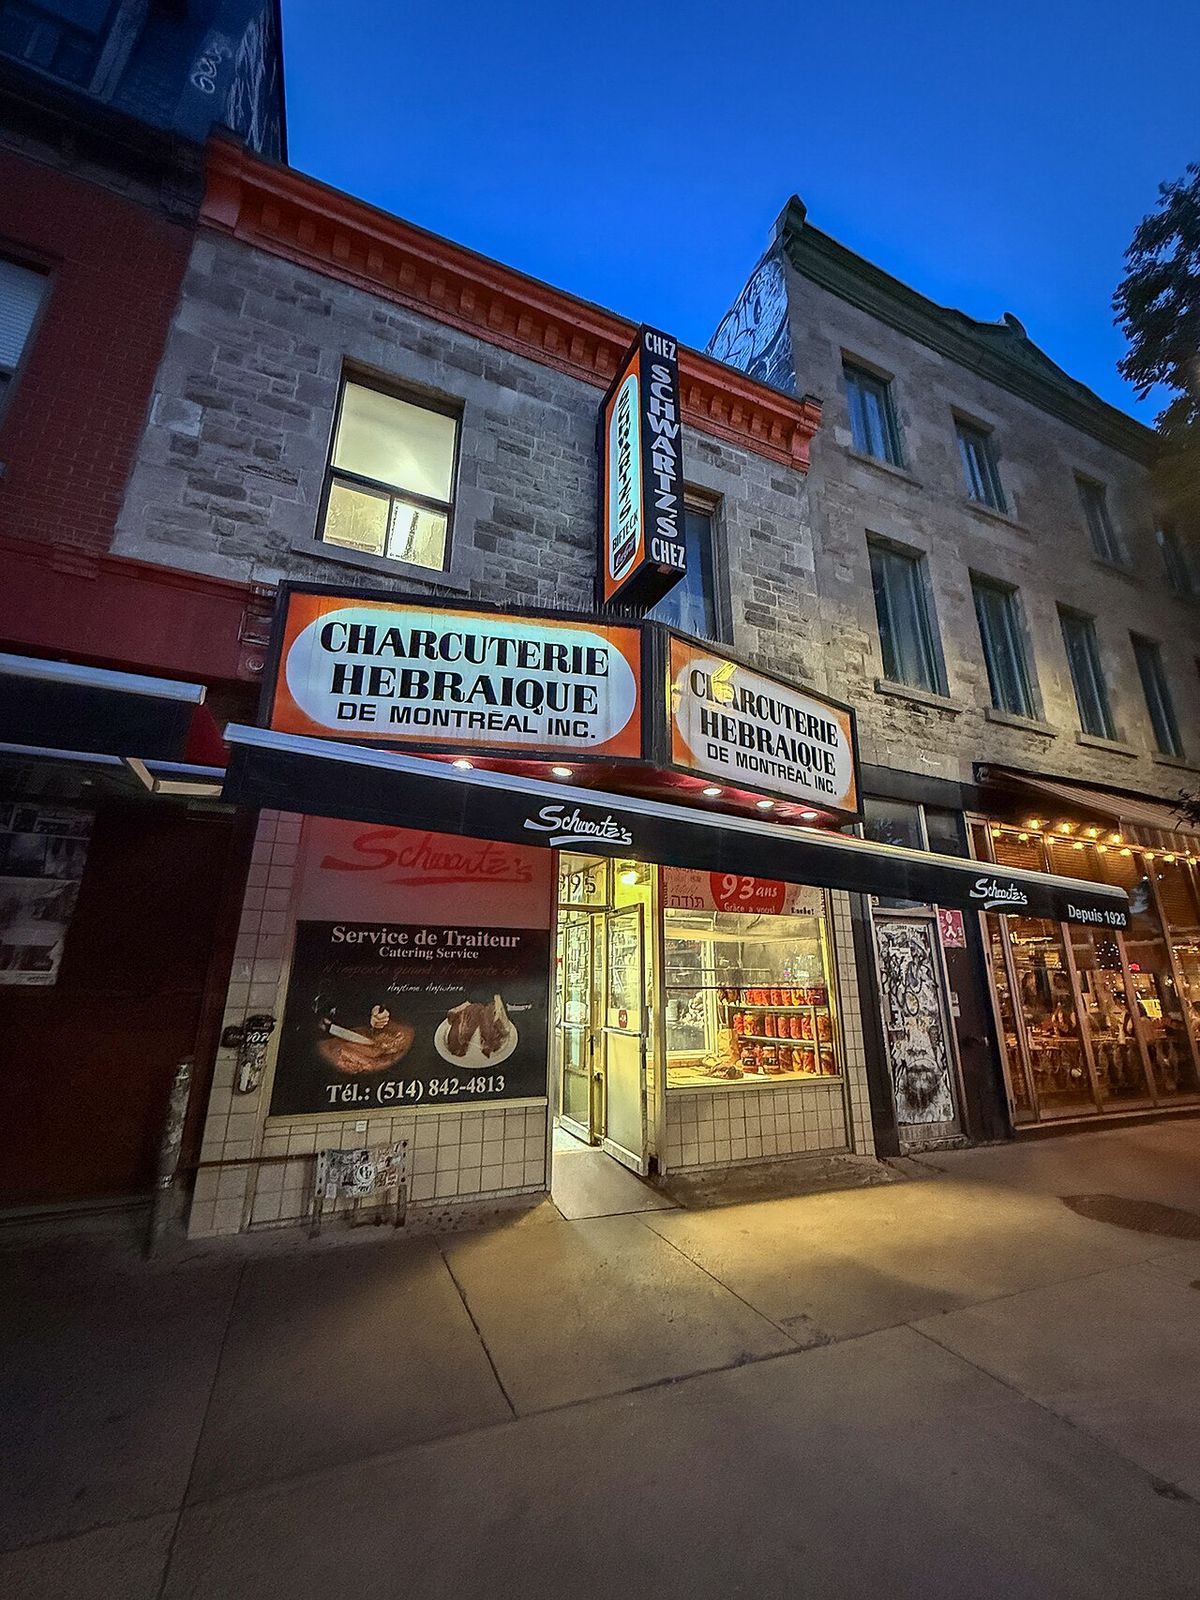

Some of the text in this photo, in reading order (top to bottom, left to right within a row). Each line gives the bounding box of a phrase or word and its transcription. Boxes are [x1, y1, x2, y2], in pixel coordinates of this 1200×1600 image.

[645, 331, 677, 362] CHEZ
[647, 364, 680, 537] SCHWARTZ'S
[613, 508, 639, 552] BIFTECK
[651, 538, 686, 569] CHEZ
[320, 622, 609, 678] CHARCUTERIE
[329, 664, 599, 717] HEBRAIQUE
[337, 702, 376, 723] DE
[547, 719, 596, 739] INC.
[700, 706, 836, 777] HEBRAIQUE
[707, 743, 729, 765] DE
[814, 774, 838, 796] INC.
[523, 804, 633, 847] Schwartz's
[319, 828, 534, 886] Schwartz's
[720, 873, 756, 900] 93
[756, 886, 778, 898] ans
[969, 878, 1029, 910] Schwartz's
[1068, 903, 1127, 927] Depuis 1928
[331, 925, 520, 947] Service de Traiteur
[379, 946, 479, 960] Catering Service
[325, 1075, 506, 1105] Tél.: (514) 842-4813
